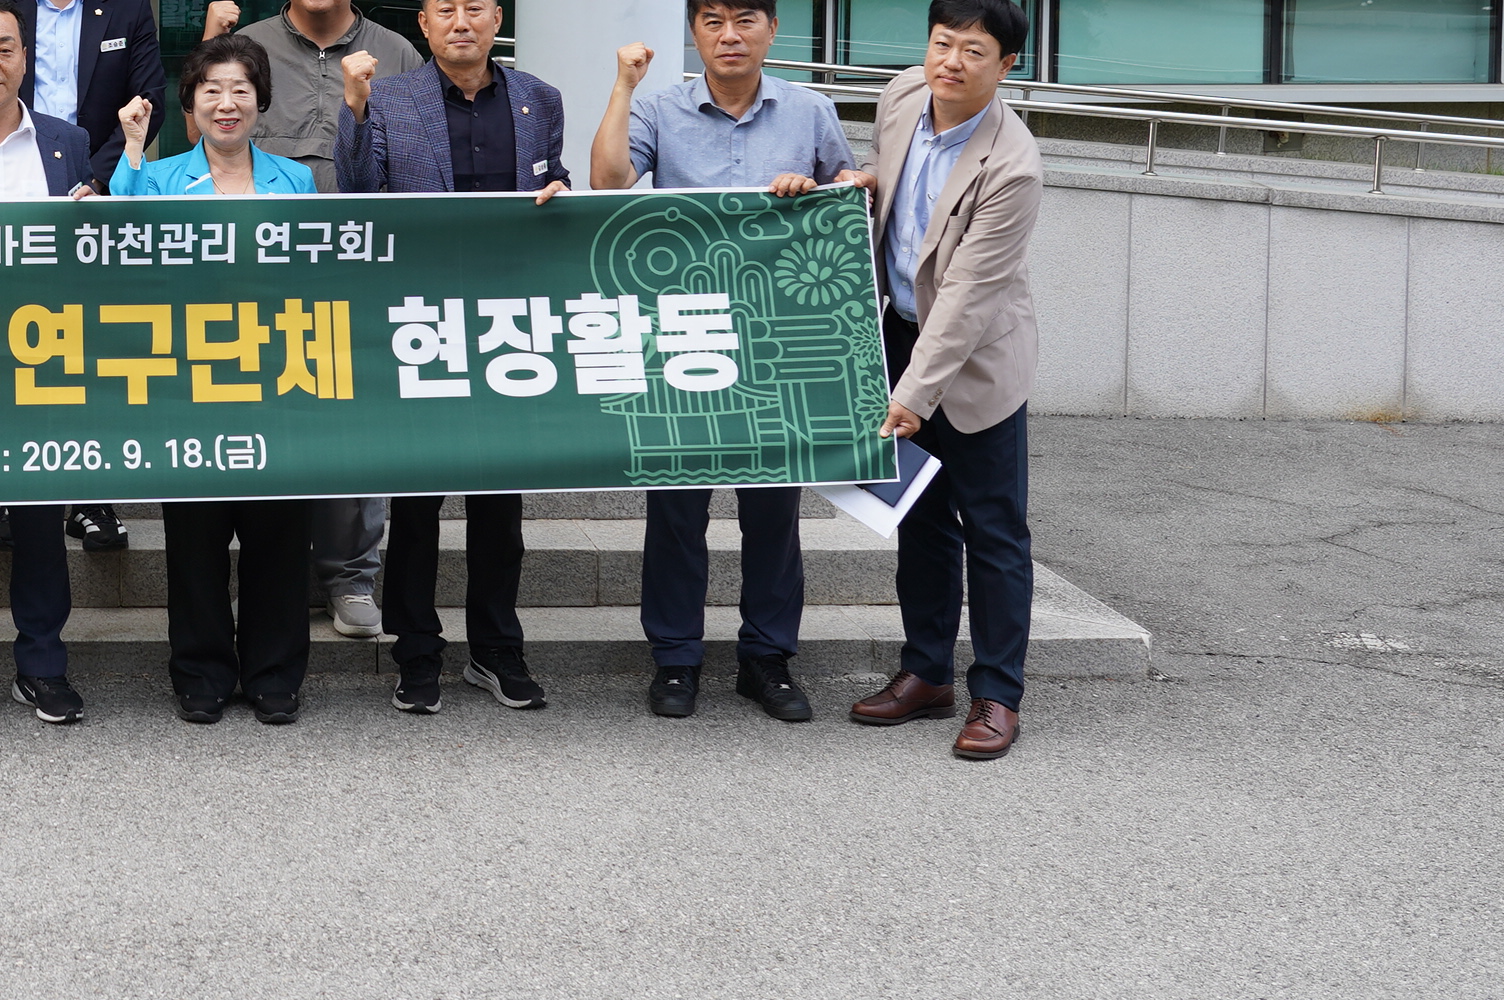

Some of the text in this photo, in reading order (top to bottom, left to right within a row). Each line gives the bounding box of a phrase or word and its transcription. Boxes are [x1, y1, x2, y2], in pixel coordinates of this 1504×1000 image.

[74, 222, 236, 266] 하천관리
[255, 220, 394, 264] 연구회」
[388, 292, 740, 399] 현장활동
[22, 440, 111, 472] 2026.
[122, 439, 152, 470] 9.
[165, 433, 267, 472] 18.(금)
